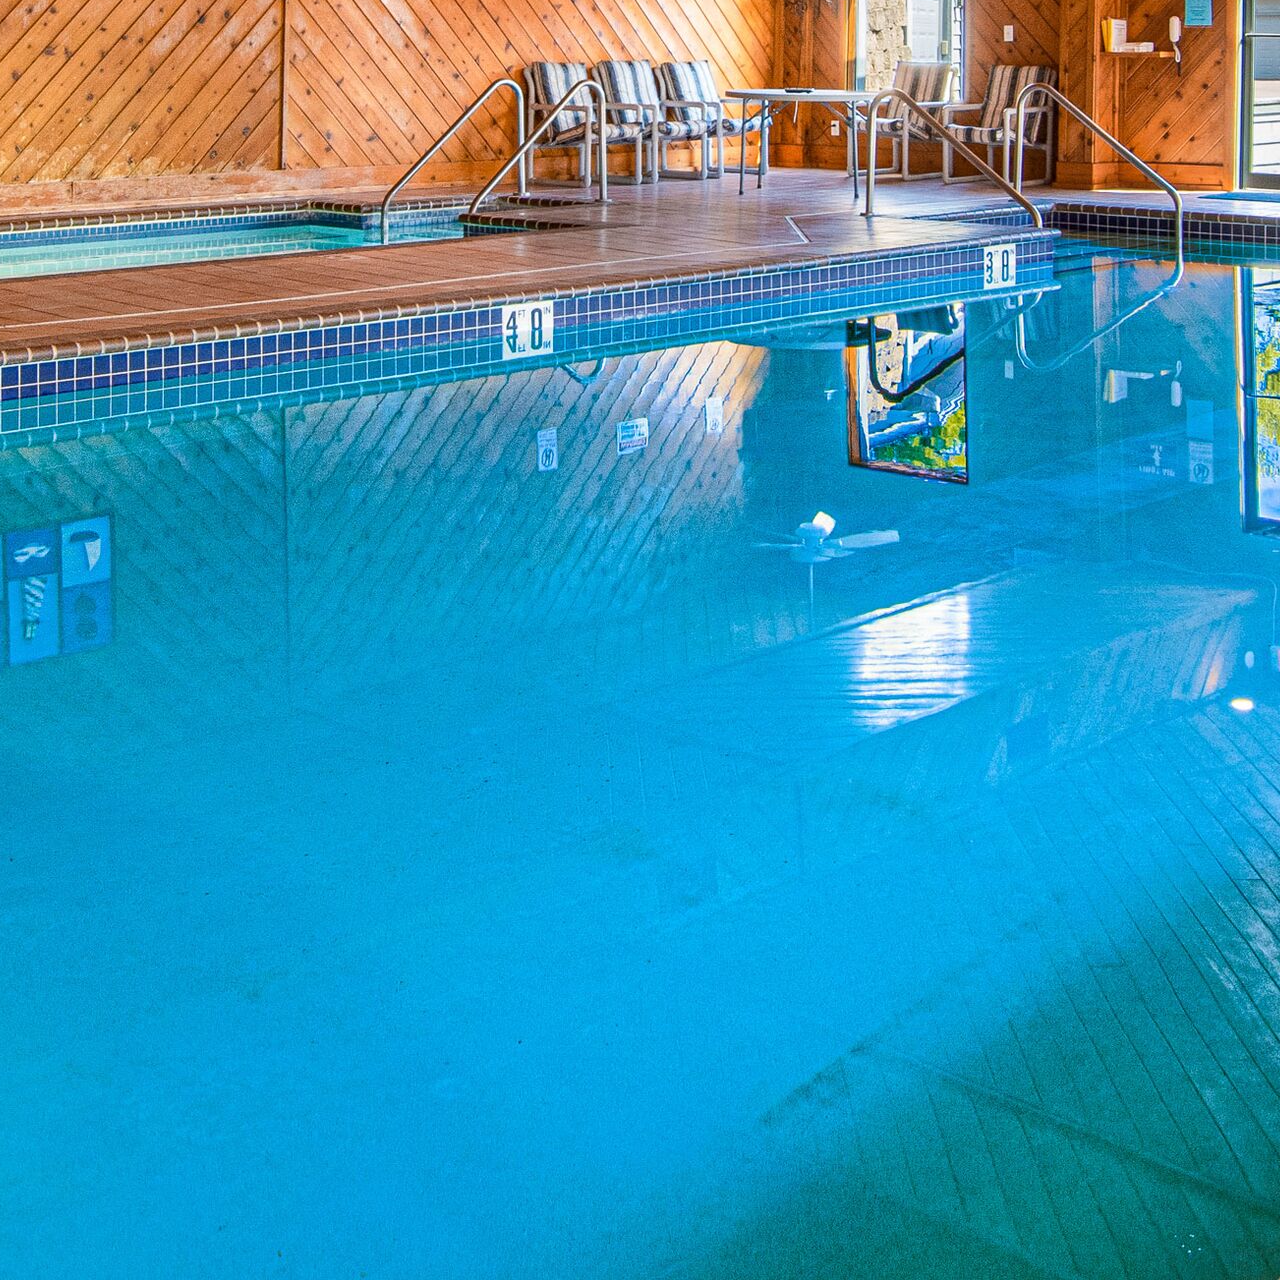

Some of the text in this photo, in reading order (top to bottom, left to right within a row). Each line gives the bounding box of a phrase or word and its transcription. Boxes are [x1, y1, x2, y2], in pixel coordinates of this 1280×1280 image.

[986, 251, 993, 268] 3
[506, 306, 551, 330] 4 FT 0 IN
